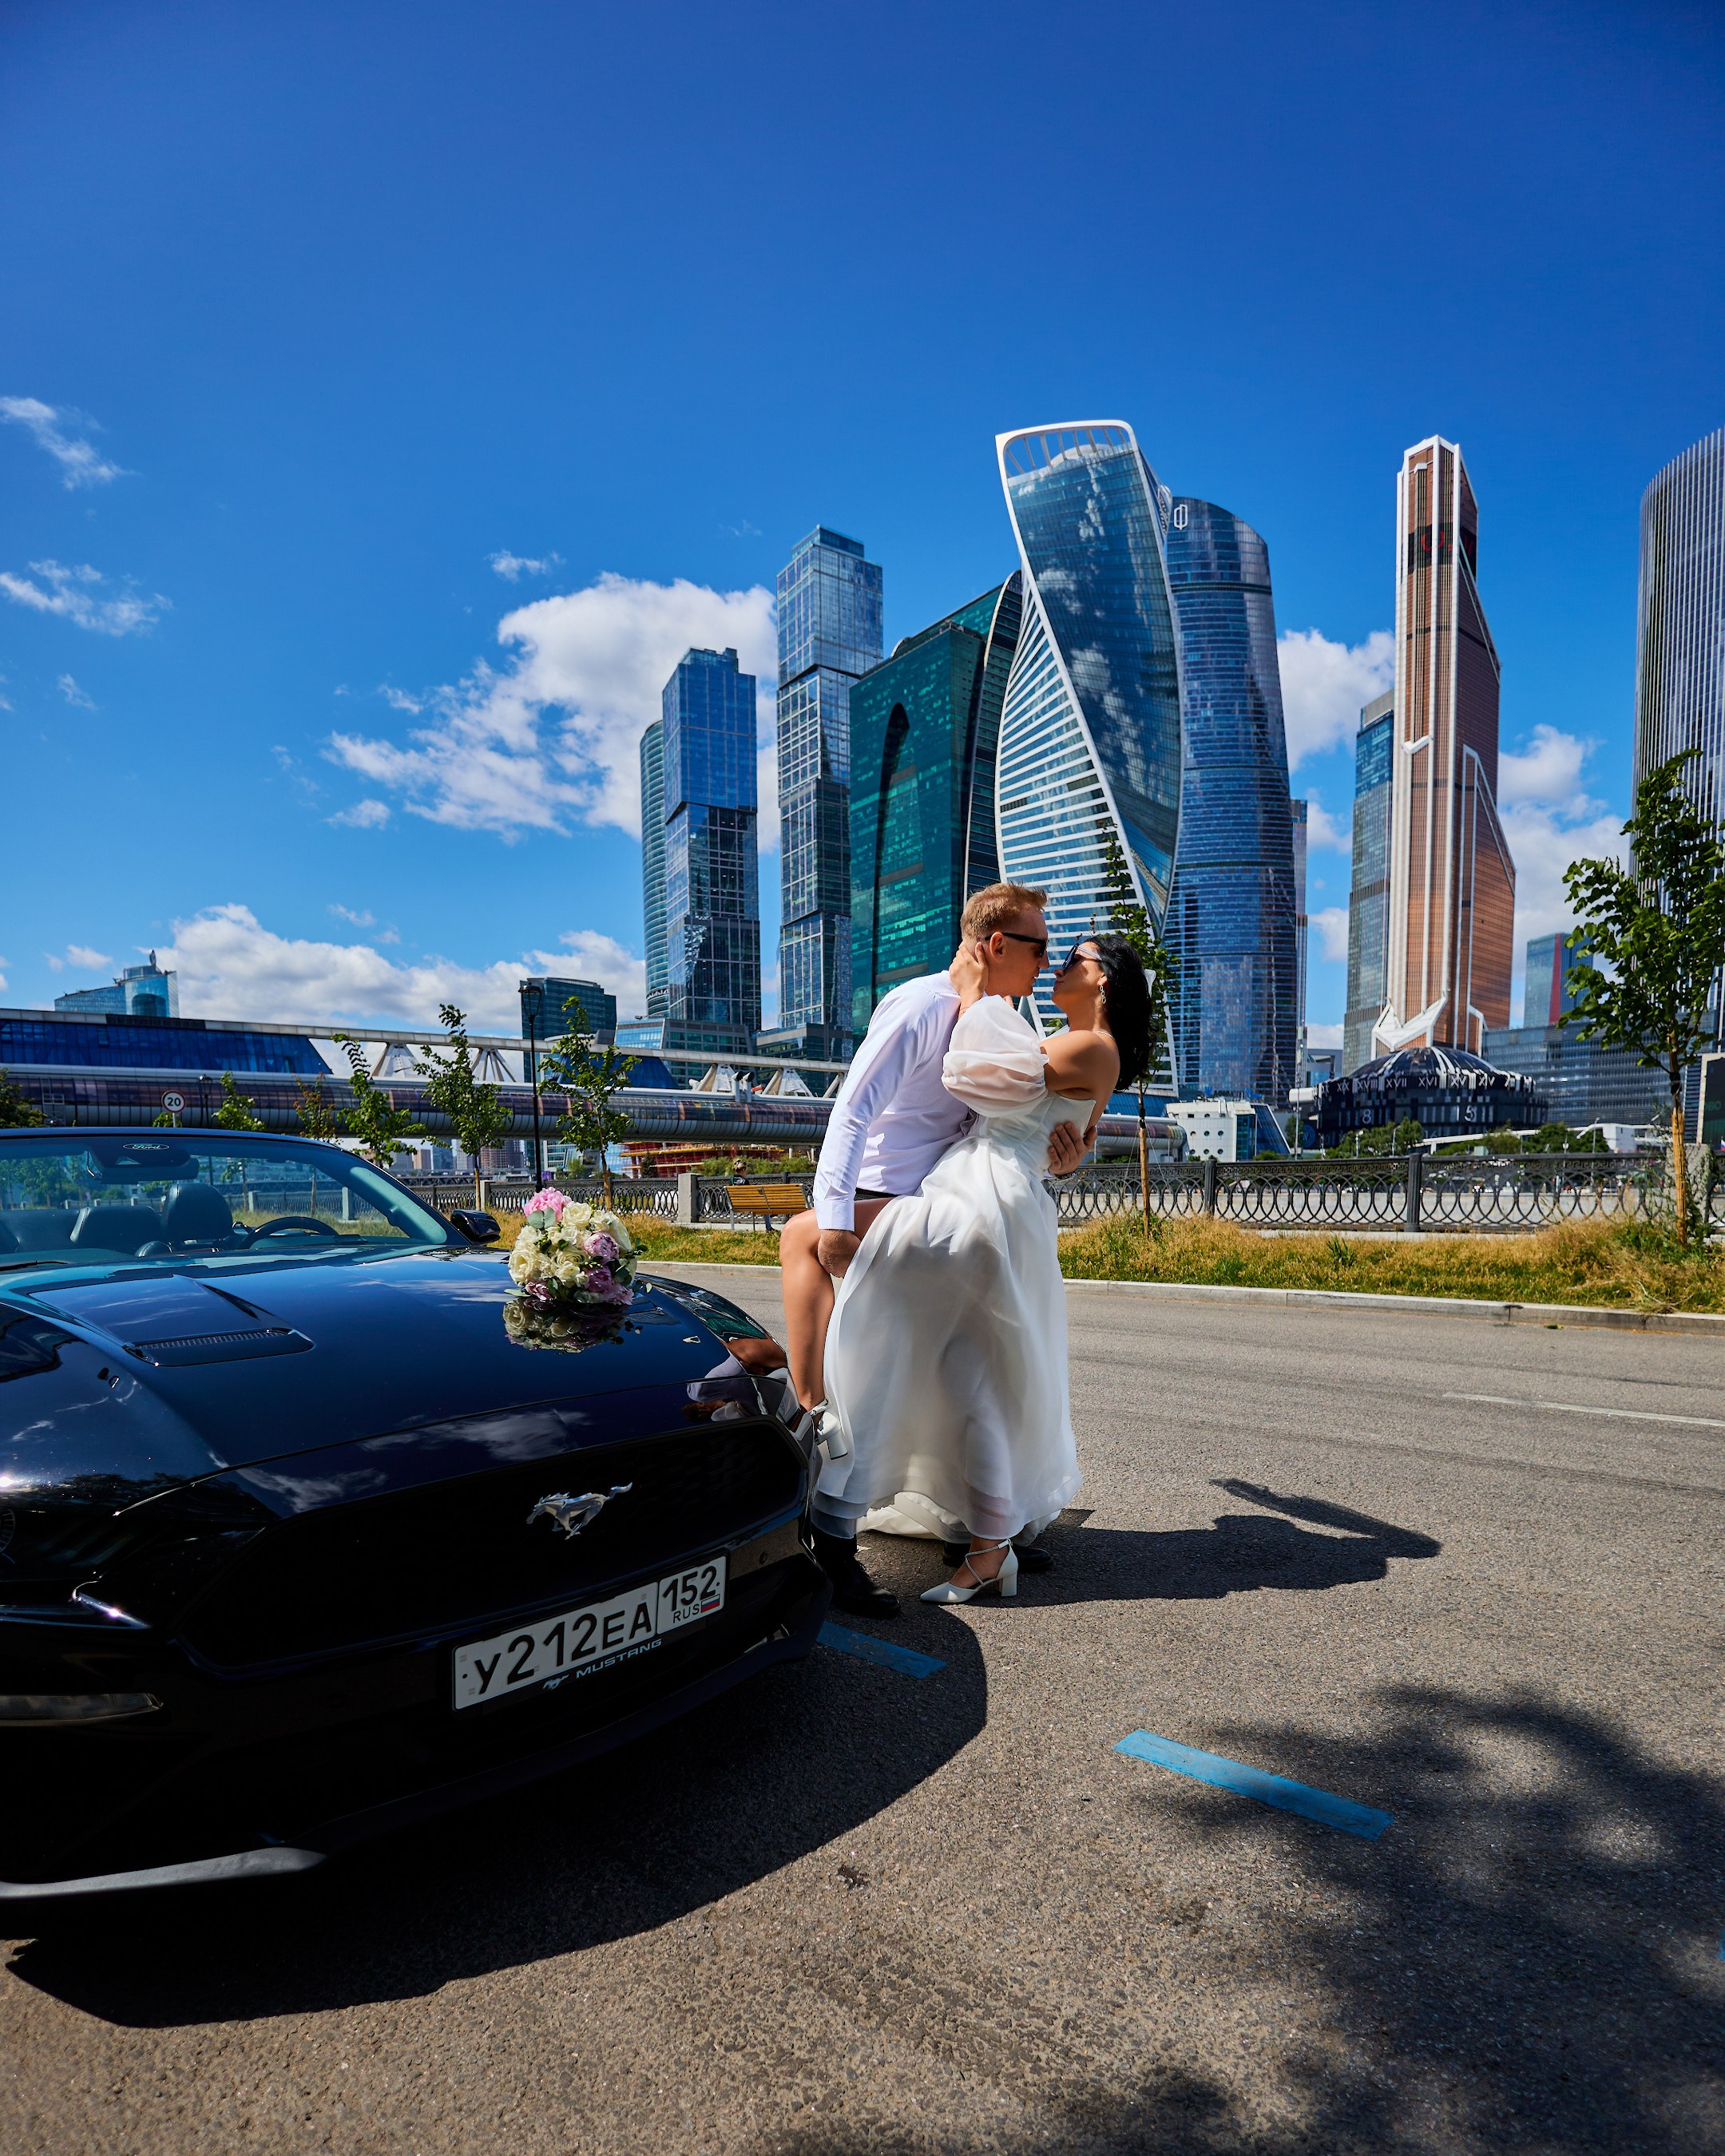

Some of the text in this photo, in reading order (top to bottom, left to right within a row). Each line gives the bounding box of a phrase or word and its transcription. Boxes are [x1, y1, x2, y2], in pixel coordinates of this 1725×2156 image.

[1386, 1077, 1407, 1089] XVII
[167, 1097, 181, 1107] 20
[662, 1565, 718, 1611] 152
[672, 1603, 700, 1623] RUS
[576, 1638, 662, 1679] MUSTANG
